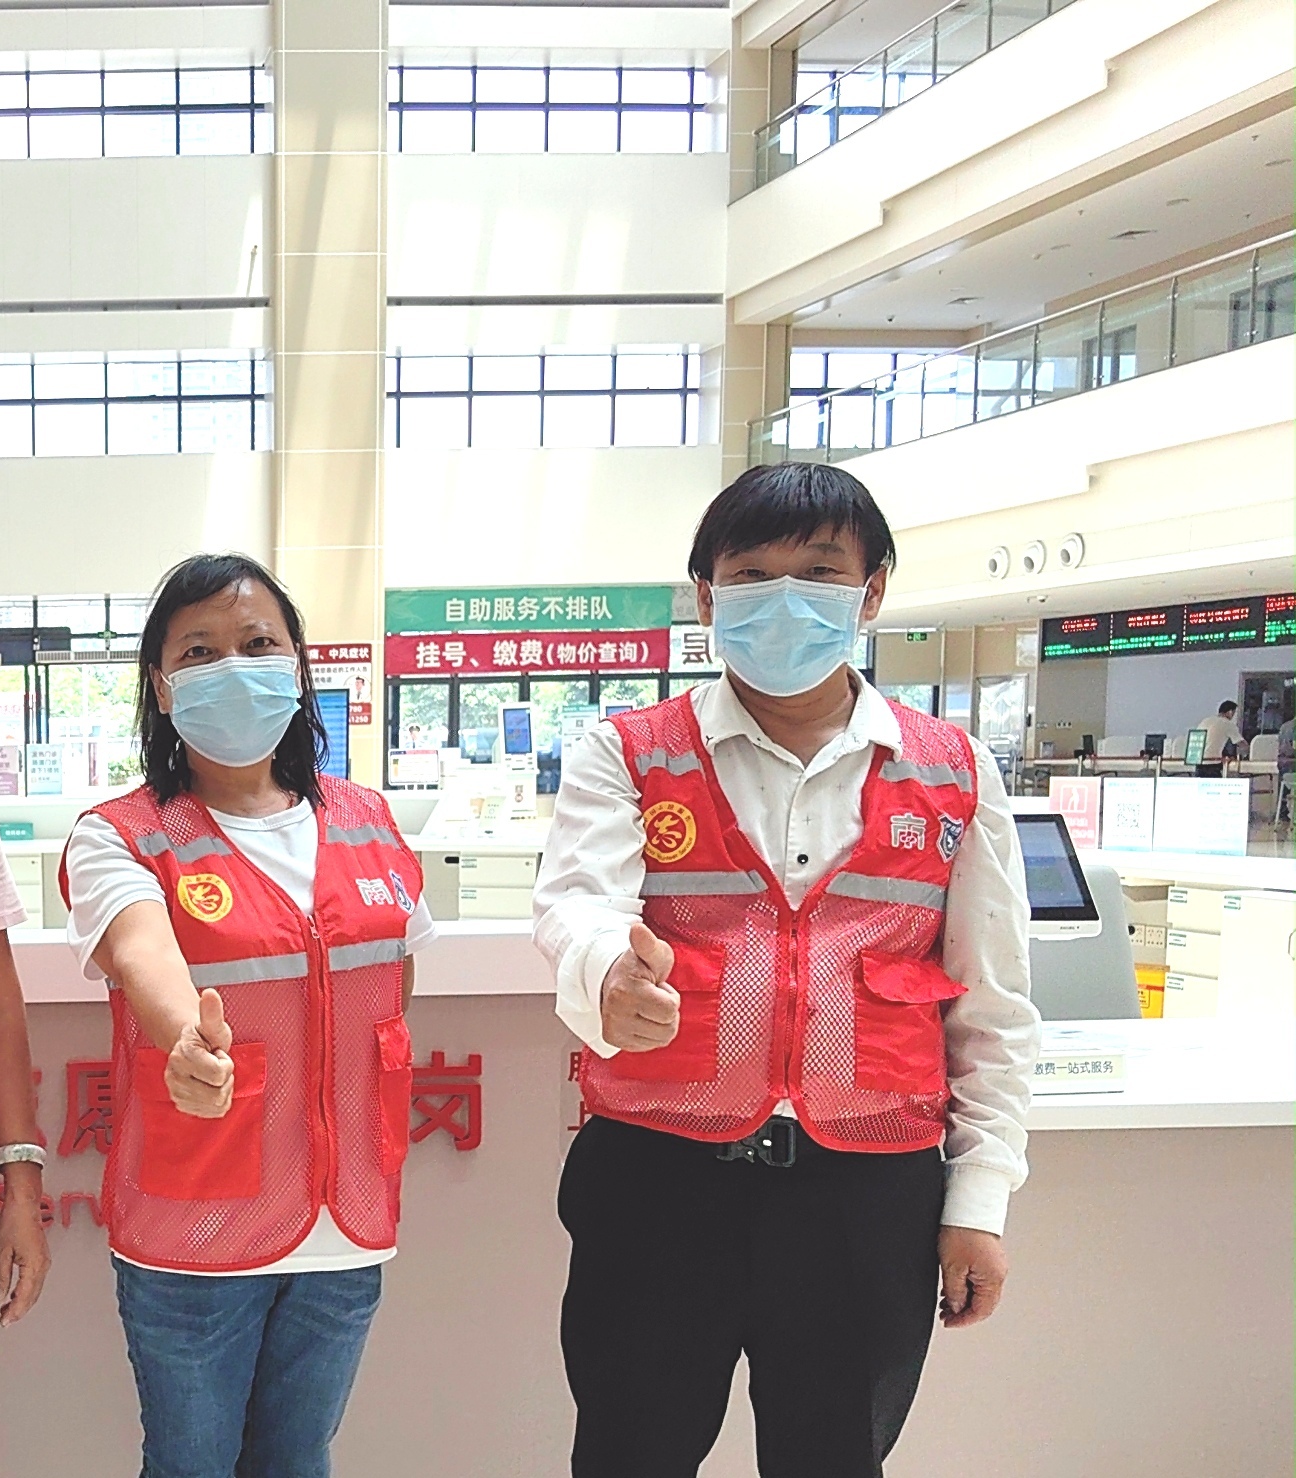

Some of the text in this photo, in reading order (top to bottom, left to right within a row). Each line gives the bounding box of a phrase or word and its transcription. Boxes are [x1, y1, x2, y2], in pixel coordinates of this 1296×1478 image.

[445, 595, 613, 623] 自助服务不排队
